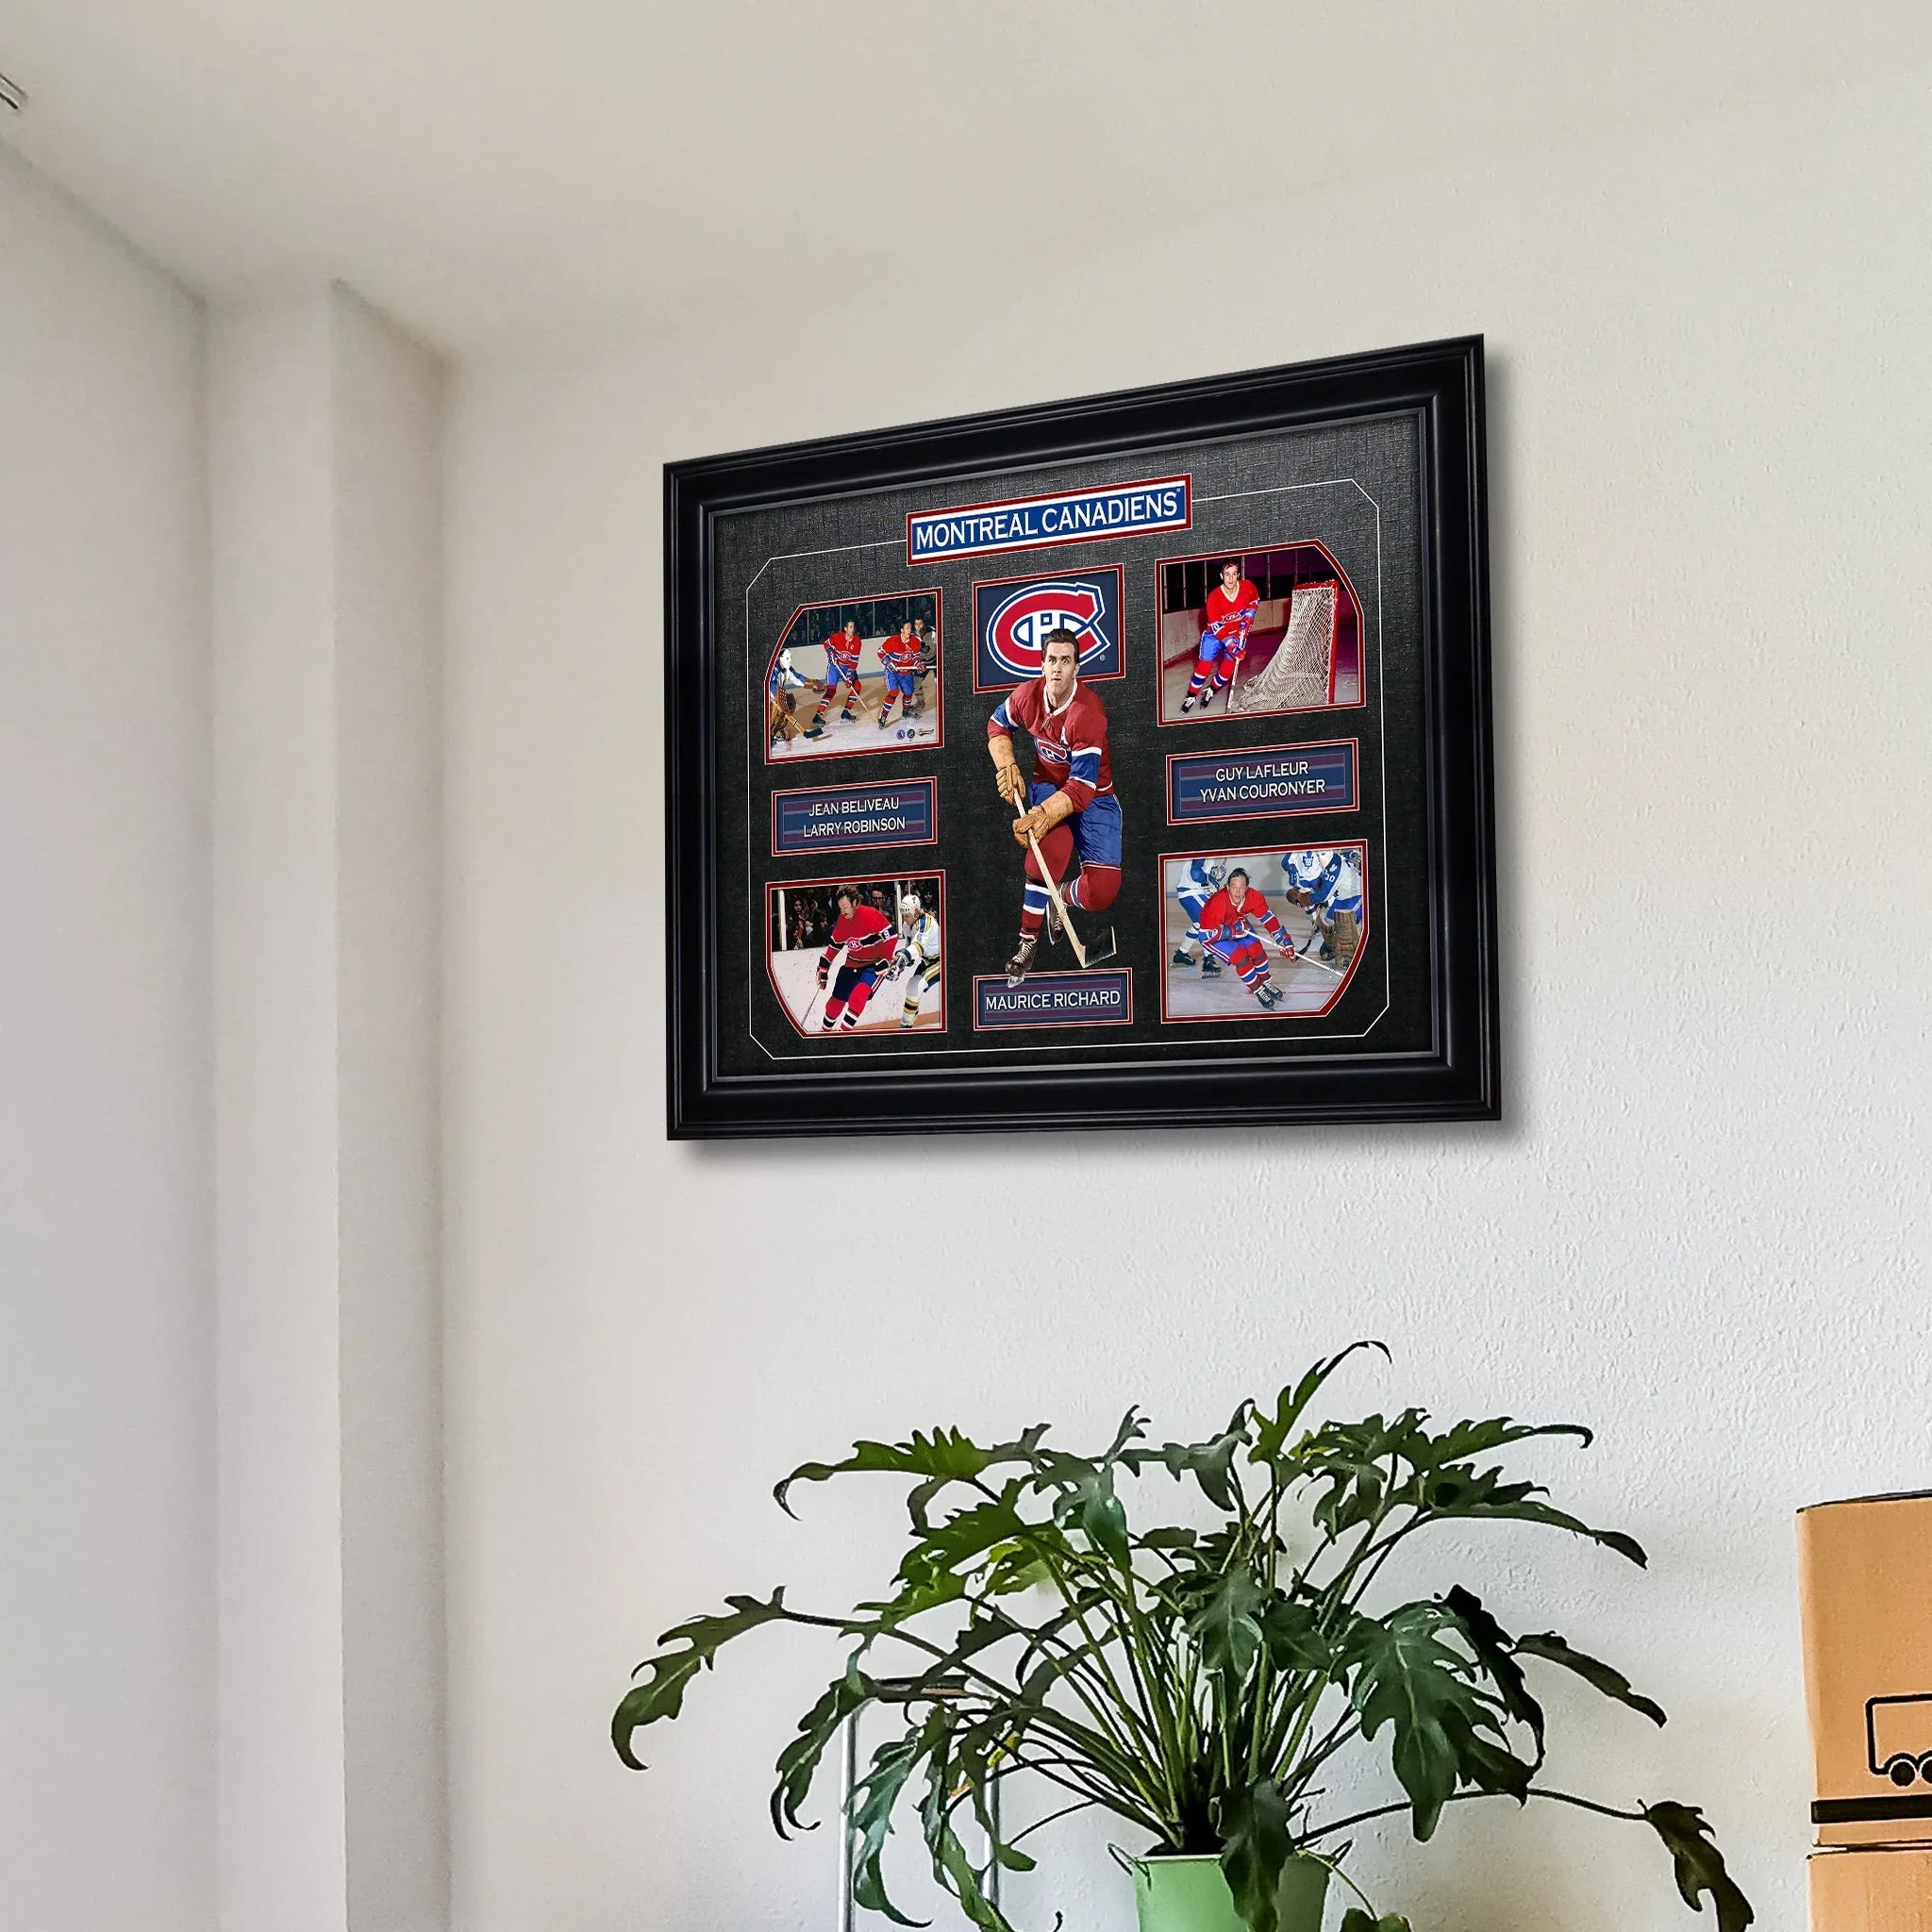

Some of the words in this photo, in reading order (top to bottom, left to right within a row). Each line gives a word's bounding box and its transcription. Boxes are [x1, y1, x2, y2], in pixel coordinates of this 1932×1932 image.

[916, 511, 1038, 551] MONTREAL
[1041, 491, 1177, 533] CANADIENS
[1215, 766, 1243, 782] GUY
[1246, 760, 1308, 779] LAFLEUR
[1200, 787, 1237, 803] YVAN
[1239, 779, 1325, 800] COURONYER
[808, 801, 840, 817] JEAN
[841, 797, 900, 814] BELIVEAU
[803, 822, 841, 838] LARRY
[843, 816, 906, 834] ROBINSON
[986, 993, 1051, 1010] MAURICE
[1054, 990, 1121, 1008] RICHARD
